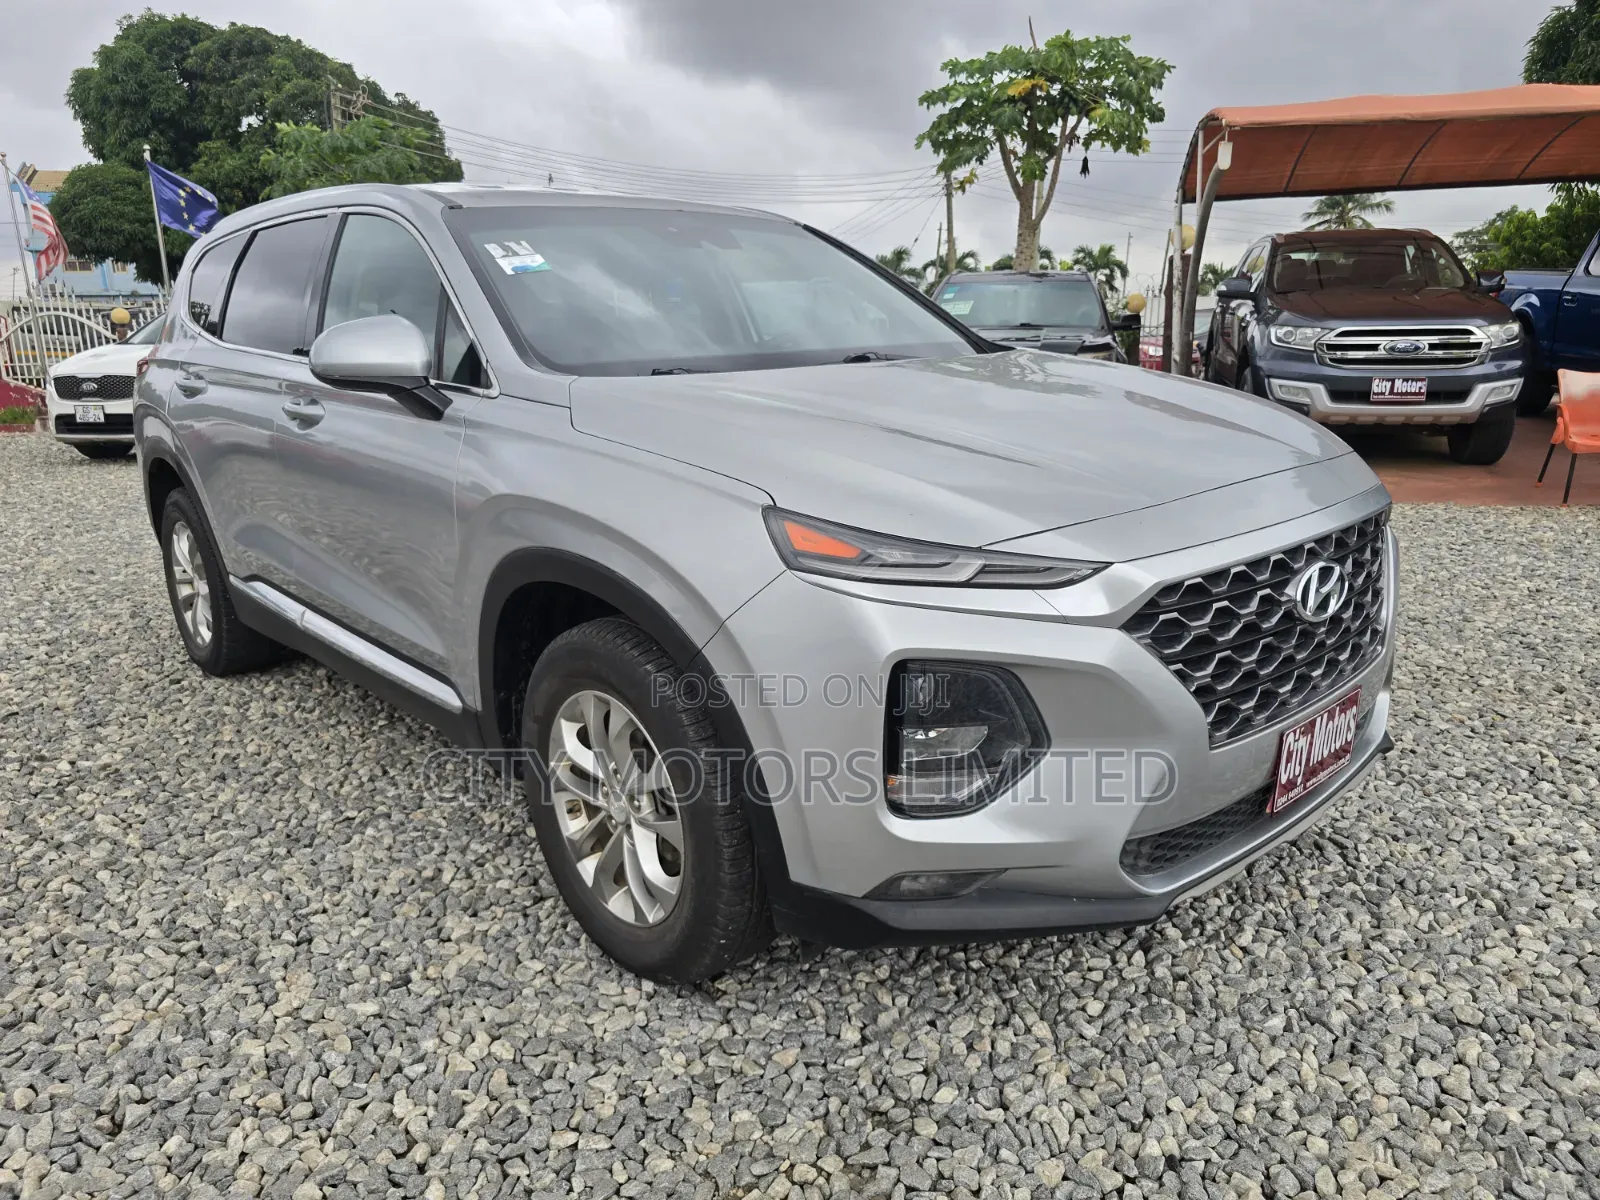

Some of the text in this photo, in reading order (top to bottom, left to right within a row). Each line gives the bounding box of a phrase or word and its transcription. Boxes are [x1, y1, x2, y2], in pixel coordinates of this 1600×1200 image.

[1373, 378, 1427, 396] City Motors
[1280, 705, 1357, 786] City Motors
